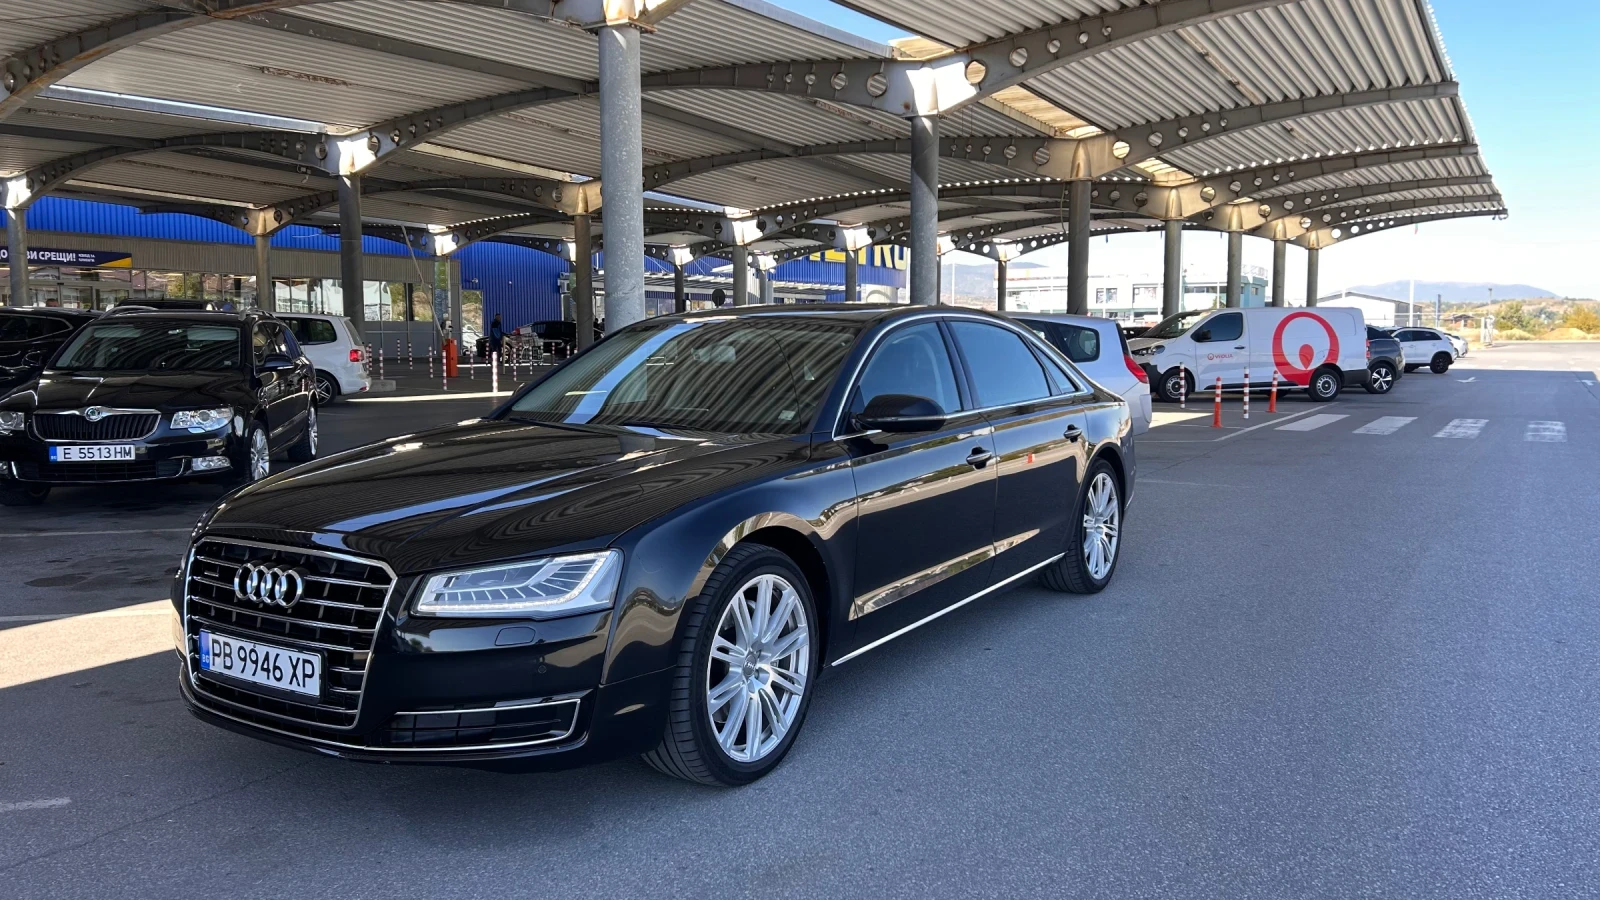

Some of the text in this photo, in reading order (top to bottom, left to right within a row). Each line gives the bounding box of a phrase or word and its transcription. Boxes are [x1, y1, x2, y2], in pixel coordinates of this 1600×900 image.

[38, 251, 76, 262] СРЕЩИ!
[63, 447, 72, 459] E
[79, 447, 111, 459] 5513
[114, 446, 132, 458] HM
[202, 638, 315, 688] BG PB 9946 XP
